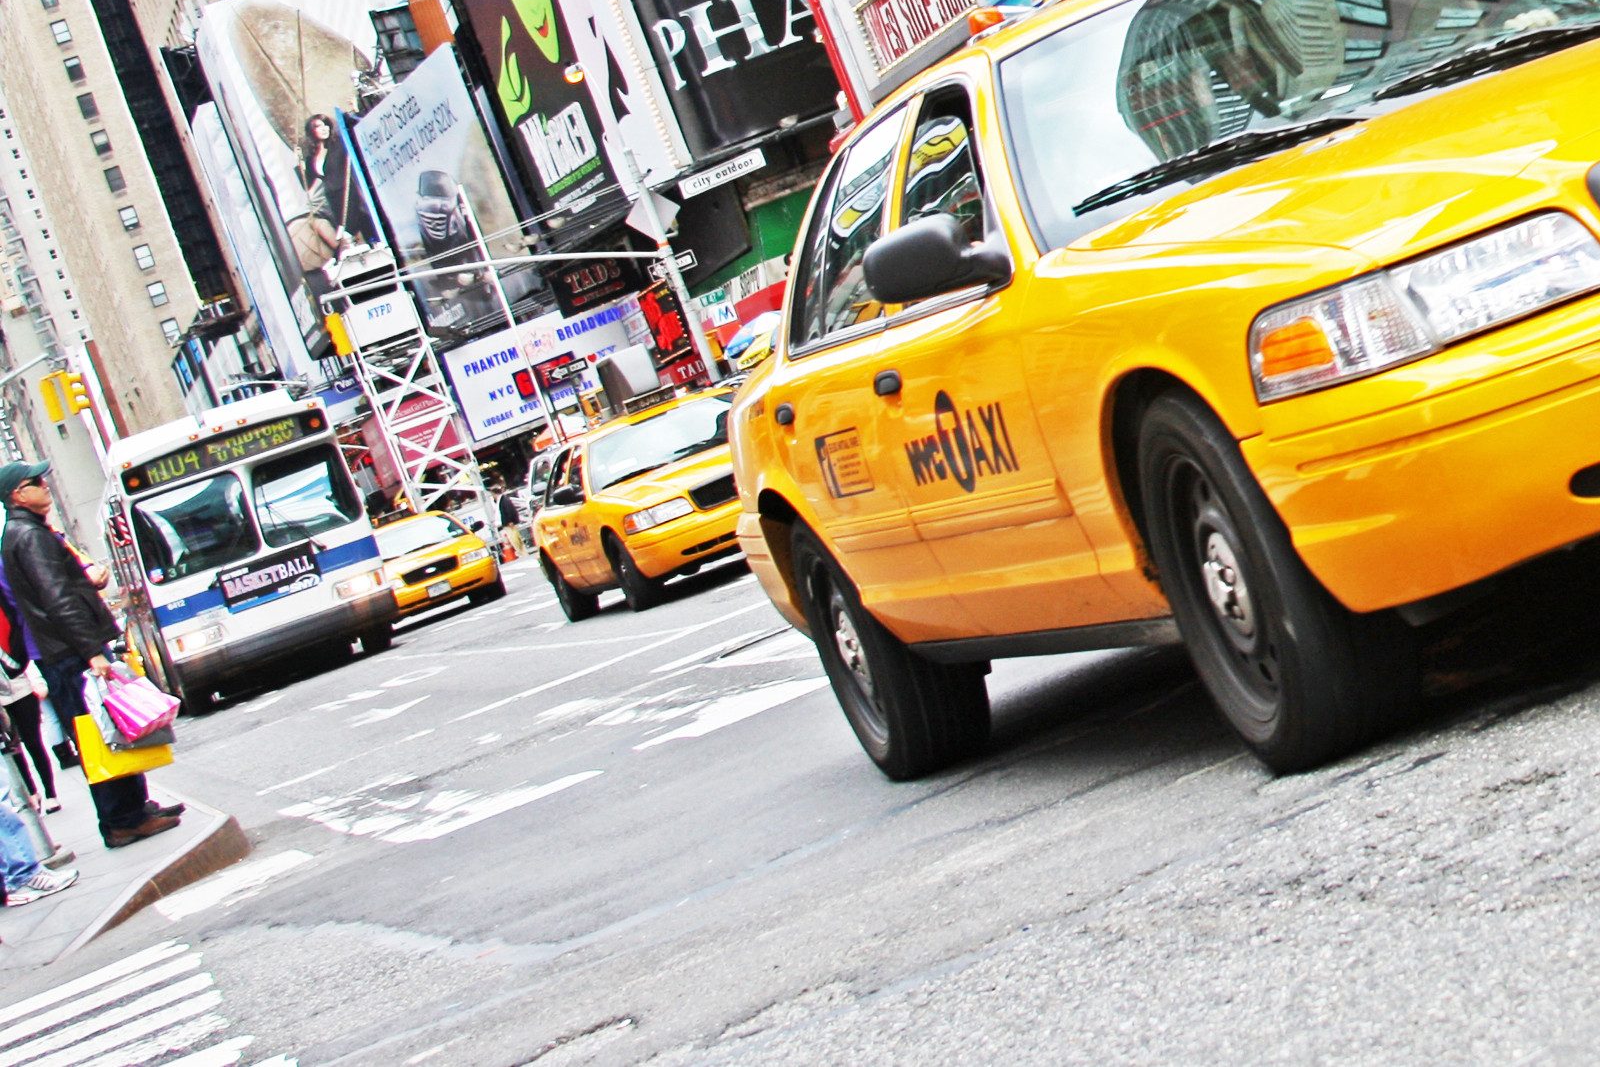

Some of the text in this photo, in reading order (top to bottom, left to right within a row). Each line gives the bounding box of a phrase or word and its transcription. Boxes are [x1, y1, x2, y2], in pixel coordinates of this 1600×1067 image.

[518, 101, 598, 189] WICKED
[692, 157, 754, 189] city outdoor
[367, 303, 393, 320] NYPD
[463, 346, 519, 377] PHANTOM
[556, 306, 624, 341] BROADWAY
[488, 384, 515, 401] NYC
[224, 419, 295, 448] MIDTOWN
[904, 434, 948, 487] NYC
[223, 555, 315, 599] BASKETBALL
